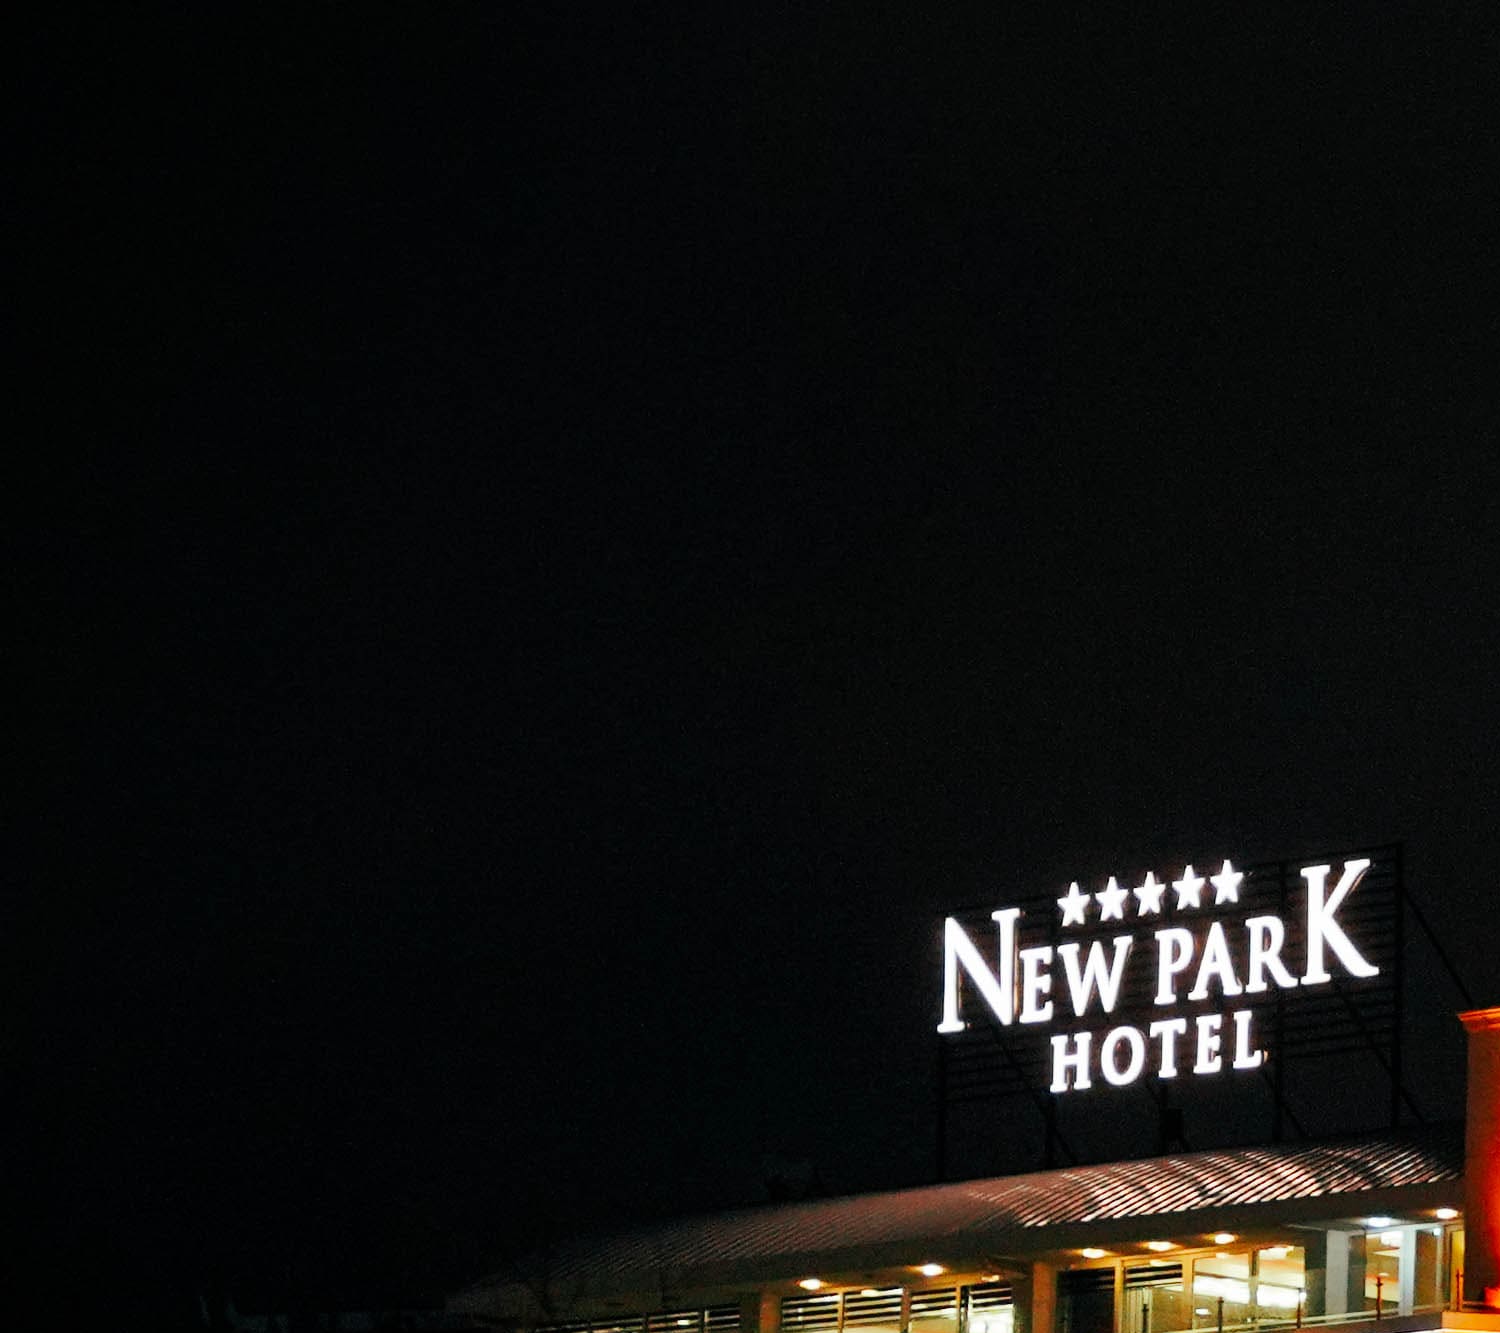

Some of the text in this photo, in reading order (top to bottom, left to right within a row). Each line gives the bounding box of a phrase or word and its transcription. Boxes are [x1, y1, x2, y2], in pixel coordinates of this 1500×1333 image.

[937, 858, 1380, 1033] NEW PARK
[1049, 1010, 1263, 1093] HOTEL
